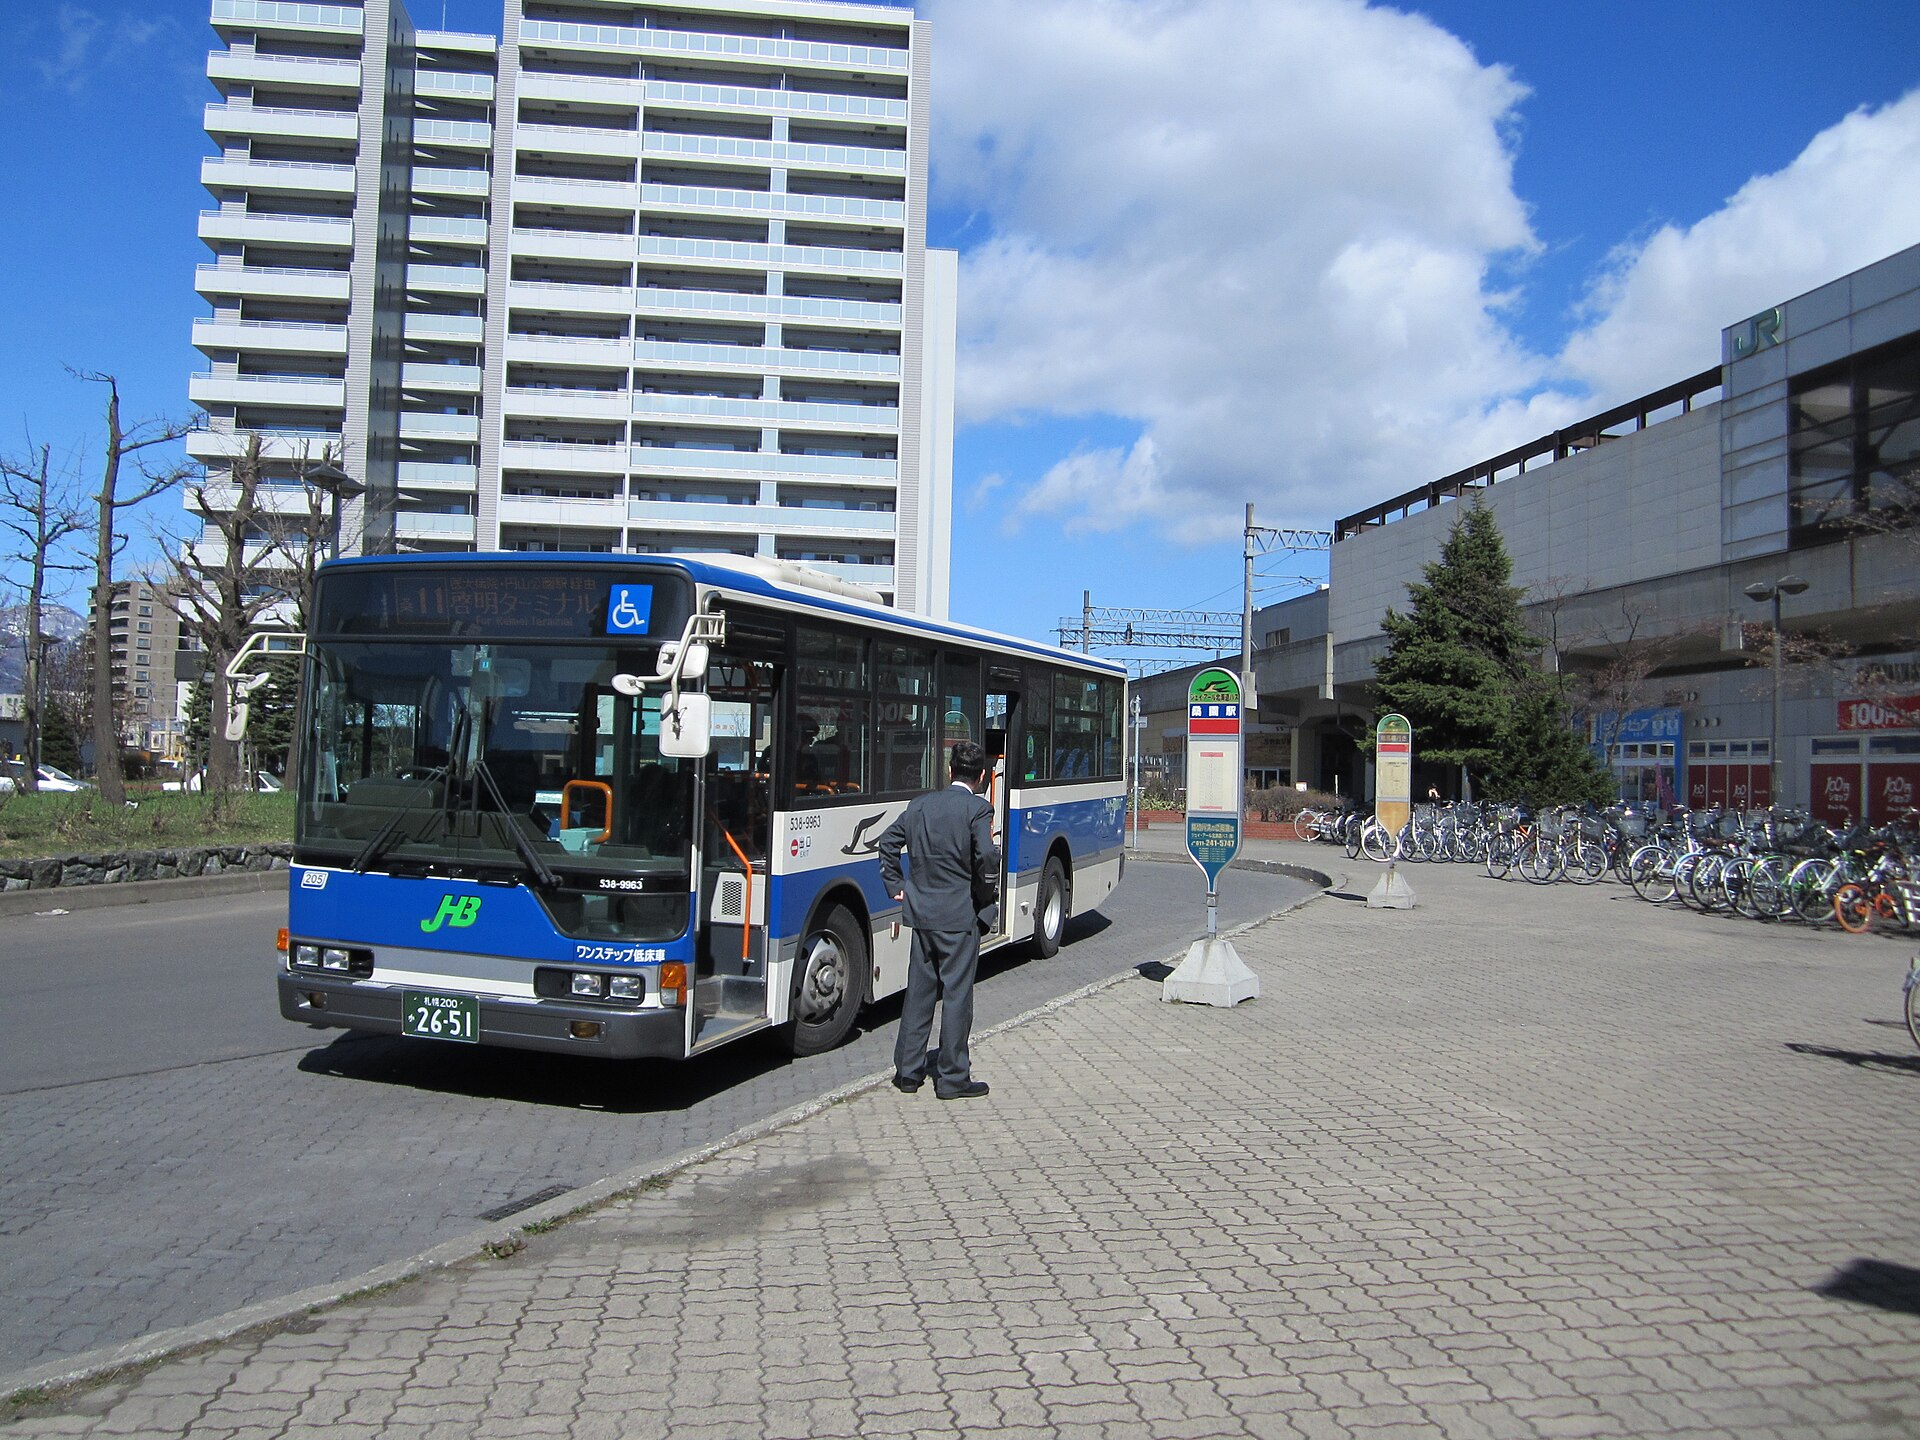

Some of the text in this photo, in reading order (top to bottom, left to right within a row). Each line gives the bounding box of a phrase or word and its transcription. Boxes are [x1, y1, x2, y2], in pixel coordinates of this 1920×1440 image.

[1734, 307, 1780, 357] JR
[790, 815, 821, 831] 538-9963
[305, 873, 324, 884] 205
[599, 878, 643, 890] 538-9963
[576, 945, 666, 963] ワンステップ低床車
[416, 1007, 472, 1037] 26-51
